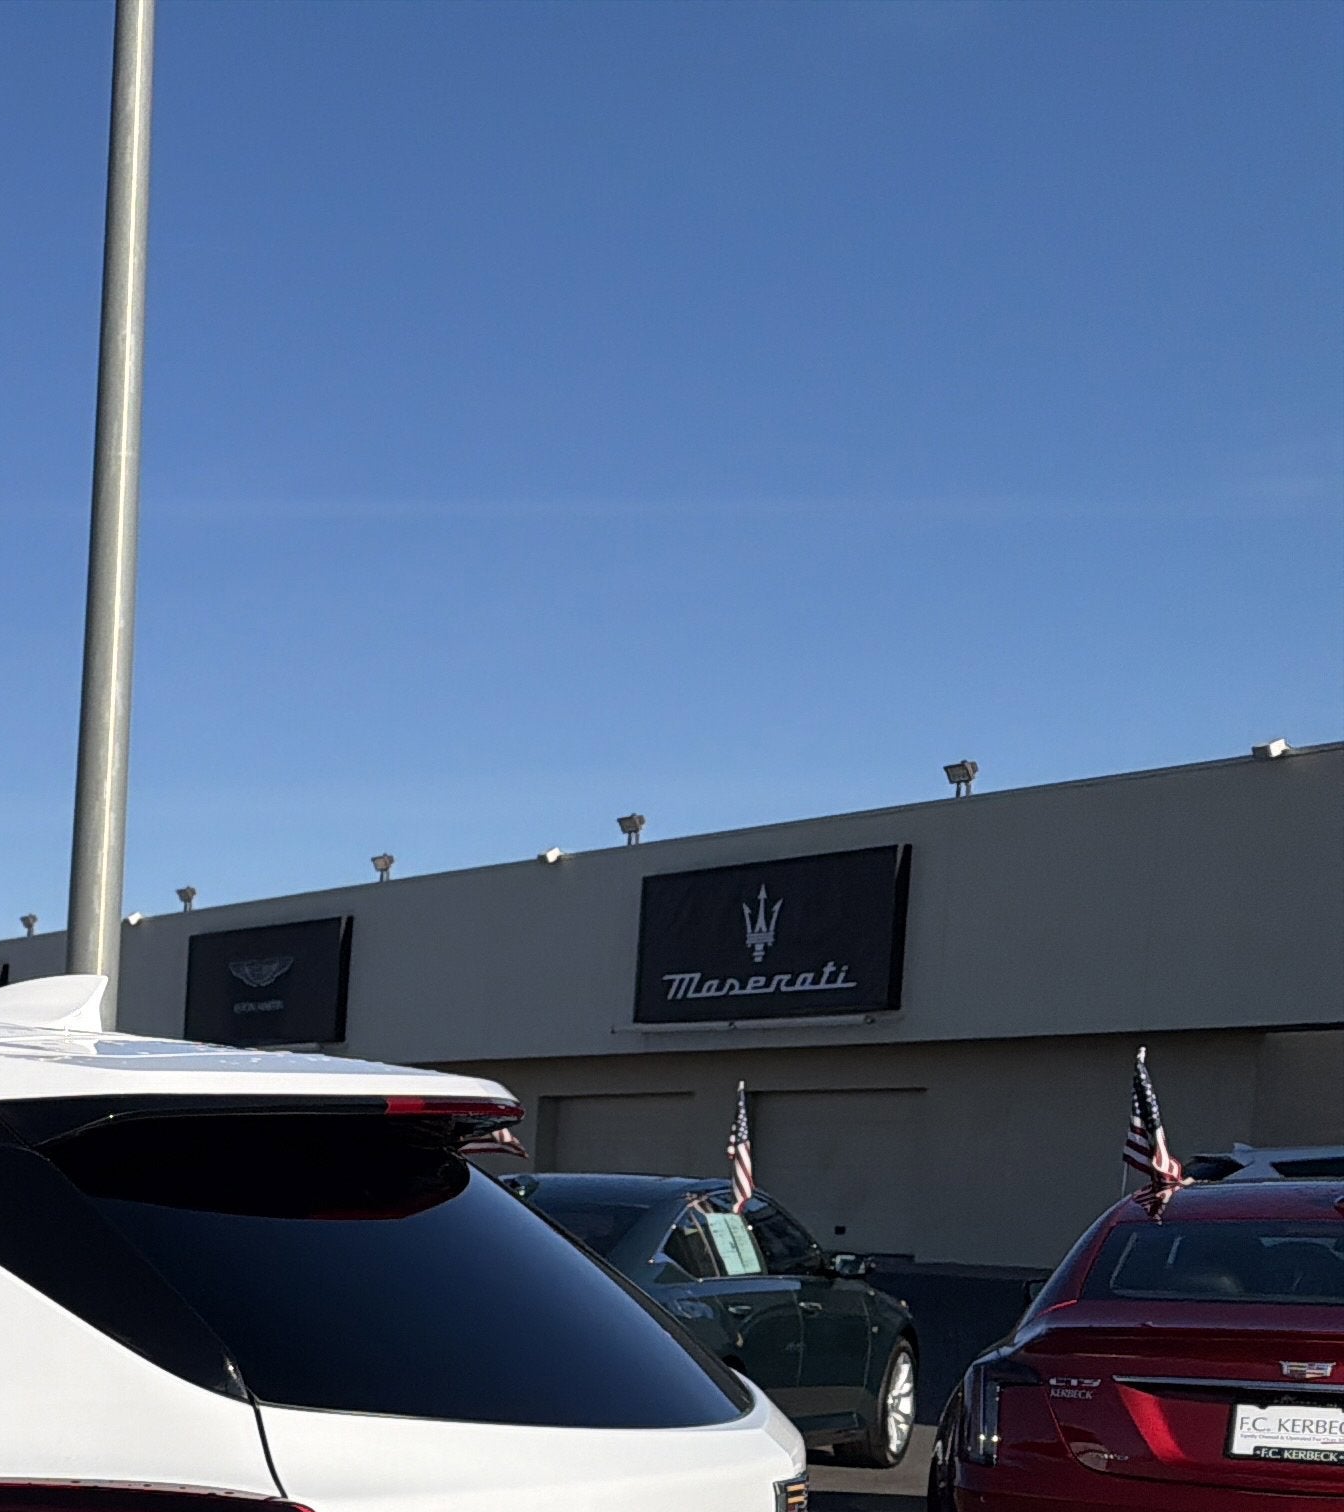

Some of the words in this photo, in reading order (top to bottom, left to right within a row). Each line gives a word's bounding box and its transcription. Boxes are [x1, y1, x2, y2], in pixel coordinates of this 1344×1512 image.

[662, 961, 858, 1000] Maserati
[1050, 1388, 1093, 1399] KERBECK
[1239, 1416, 1272, 1432] F.C.
[1283, 1449, 1339, 1463] KERBECK
